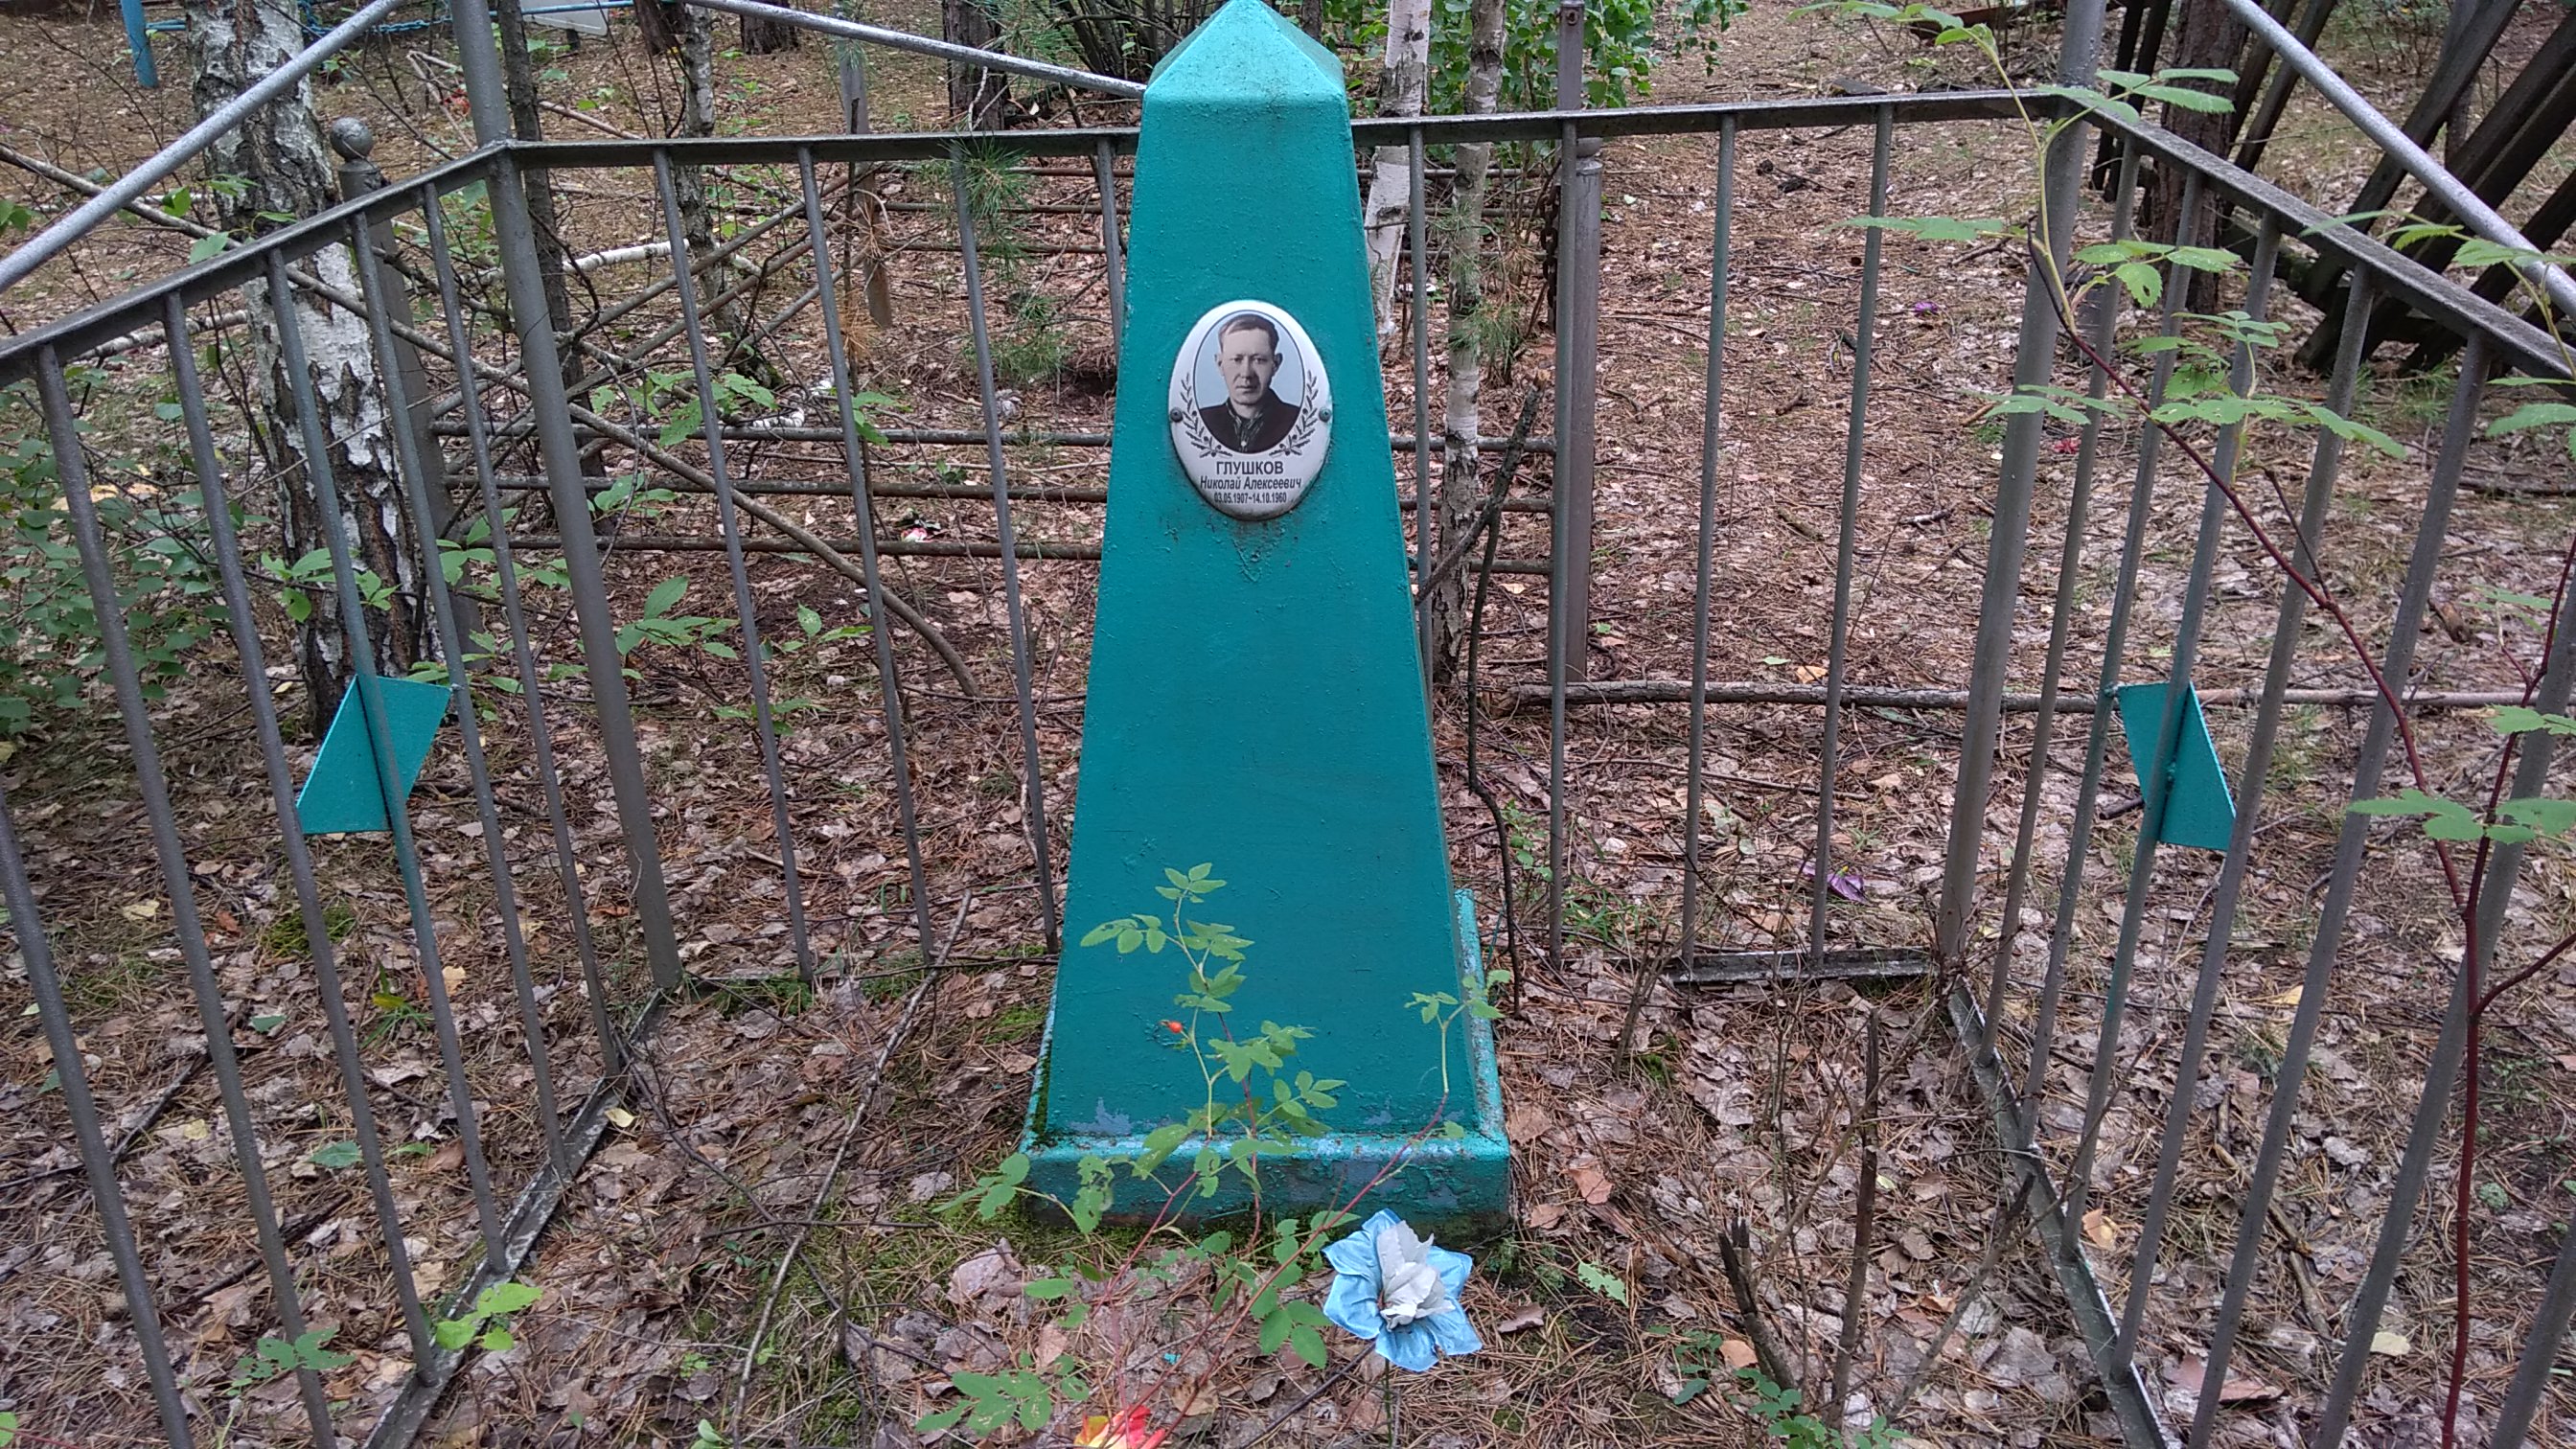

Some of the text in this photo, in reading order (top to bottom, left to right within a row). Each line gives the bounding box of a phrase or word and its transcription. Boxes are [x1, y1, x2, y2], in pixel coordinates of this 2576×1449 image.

[1216, 461, 1284, 475] ГЛУШКОВ
[1200, 475, 1302, 490] Николай Алексеевич
